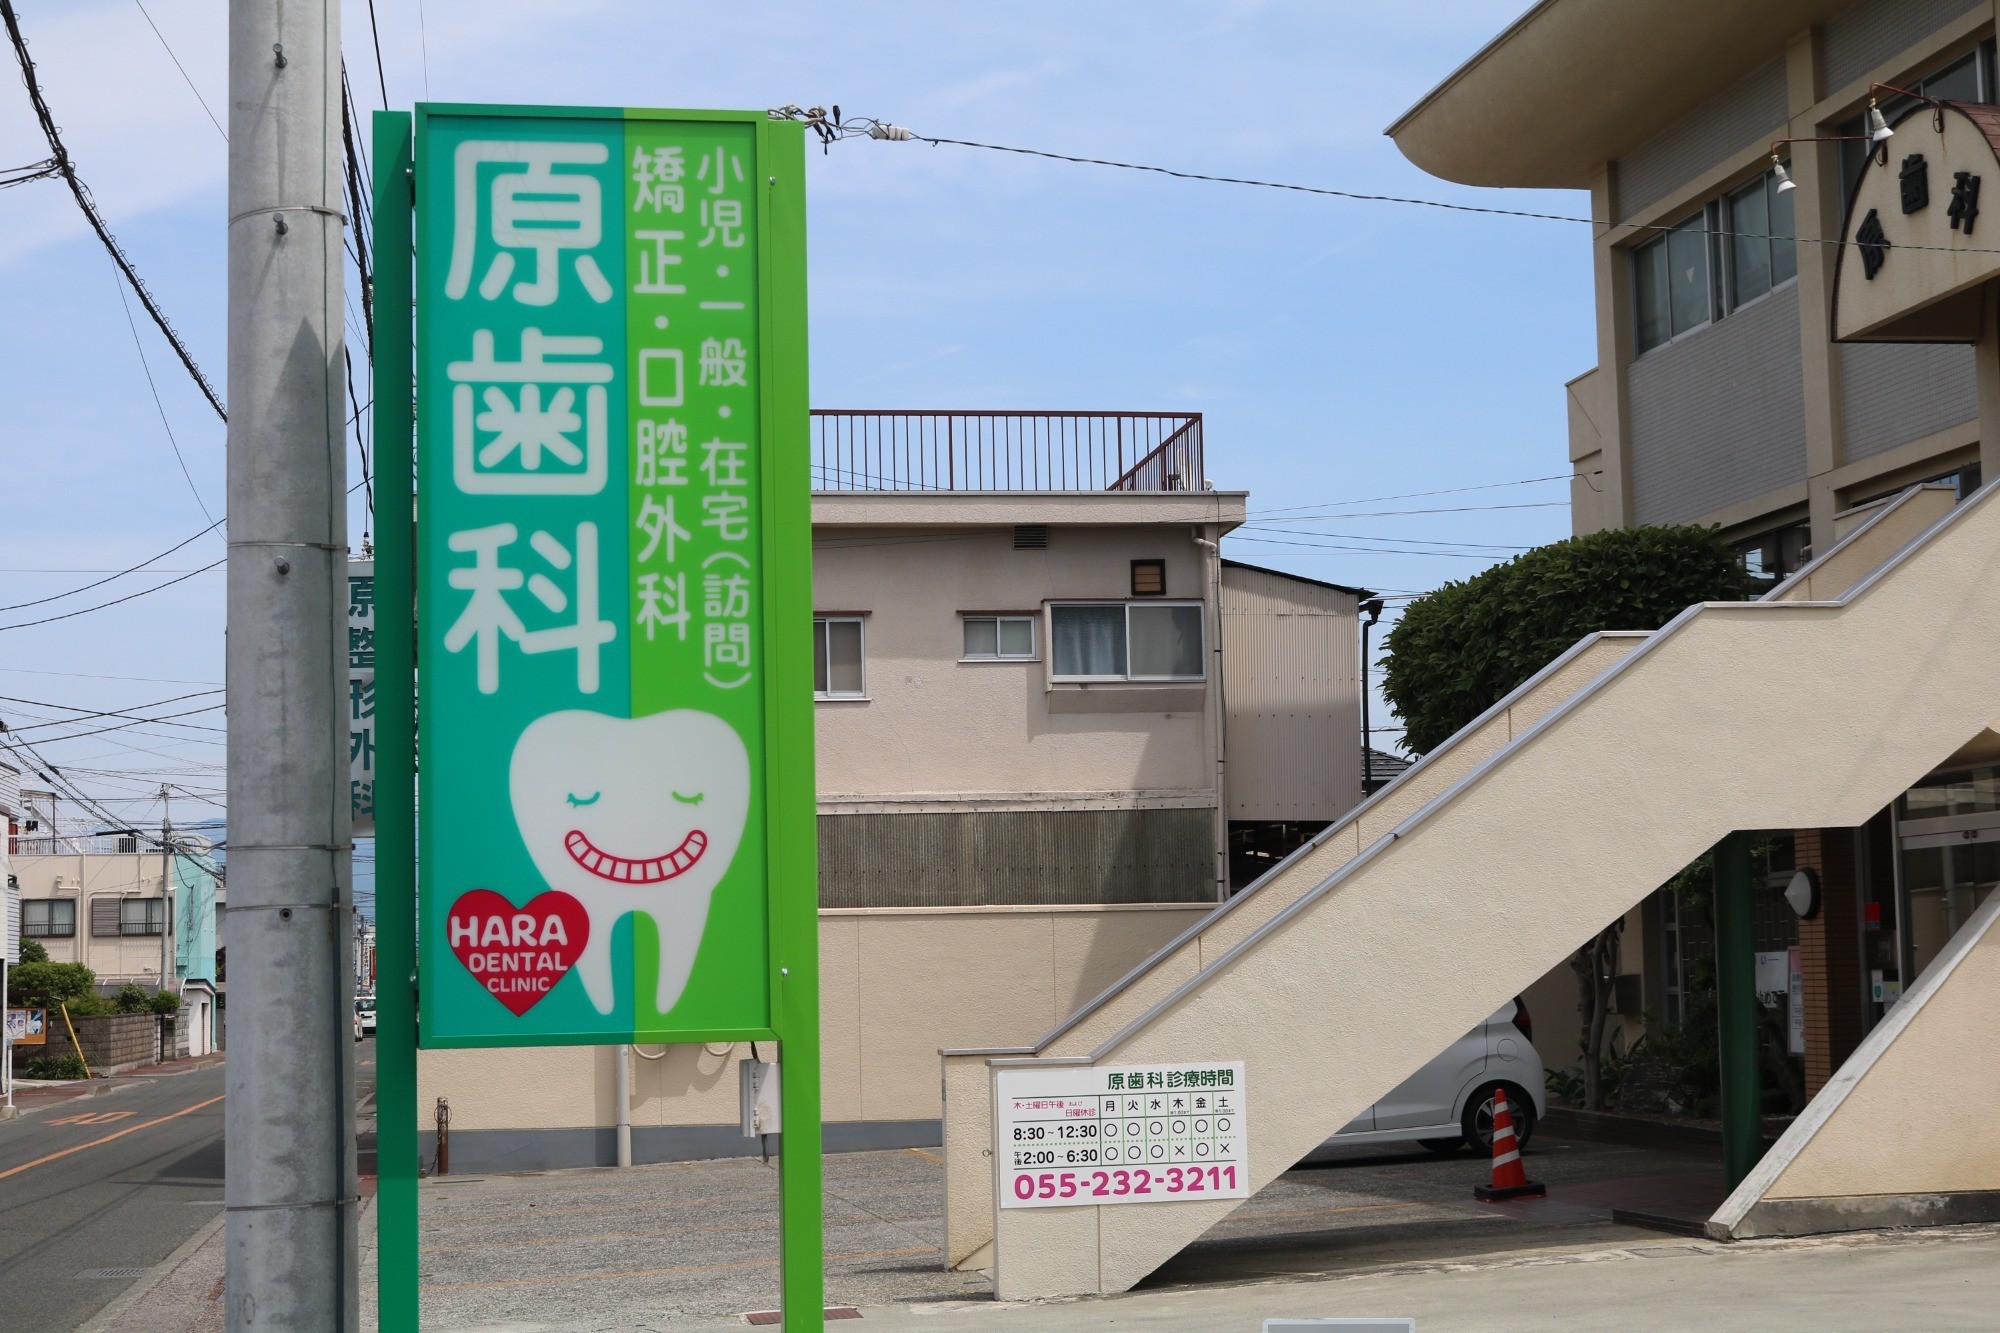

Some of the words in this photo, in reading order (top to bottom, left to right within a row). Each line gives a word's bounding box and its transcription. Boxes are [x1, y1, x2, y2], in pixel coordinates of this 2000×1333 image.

[632, 145, 692, 642] 矯正・口腔外科
[444, 139, 617, 695] 原歯科
[451, 914, 568, 947] HARA
[468, 952, 568, 973] DENTAL
[487, 976, 551, 993] CLINIC
[1108, 1069, 1234, 1090] 原歯科診療時間
[1065, 1108, 1097, 1117] 日曜休診
[1105, 1100, 1115, 1112] 月
[1127, 1100, 1139, 1111] 火
[1150, 1098, 1161, 1110] 水
[1173, 1098, 1184, 1109] 木
[1195, 1097, 1206, 1109] 金
[1218, 1096, 1229, 1108] 土
[1014, 1165, 1236, 1200] 055-232-3211
